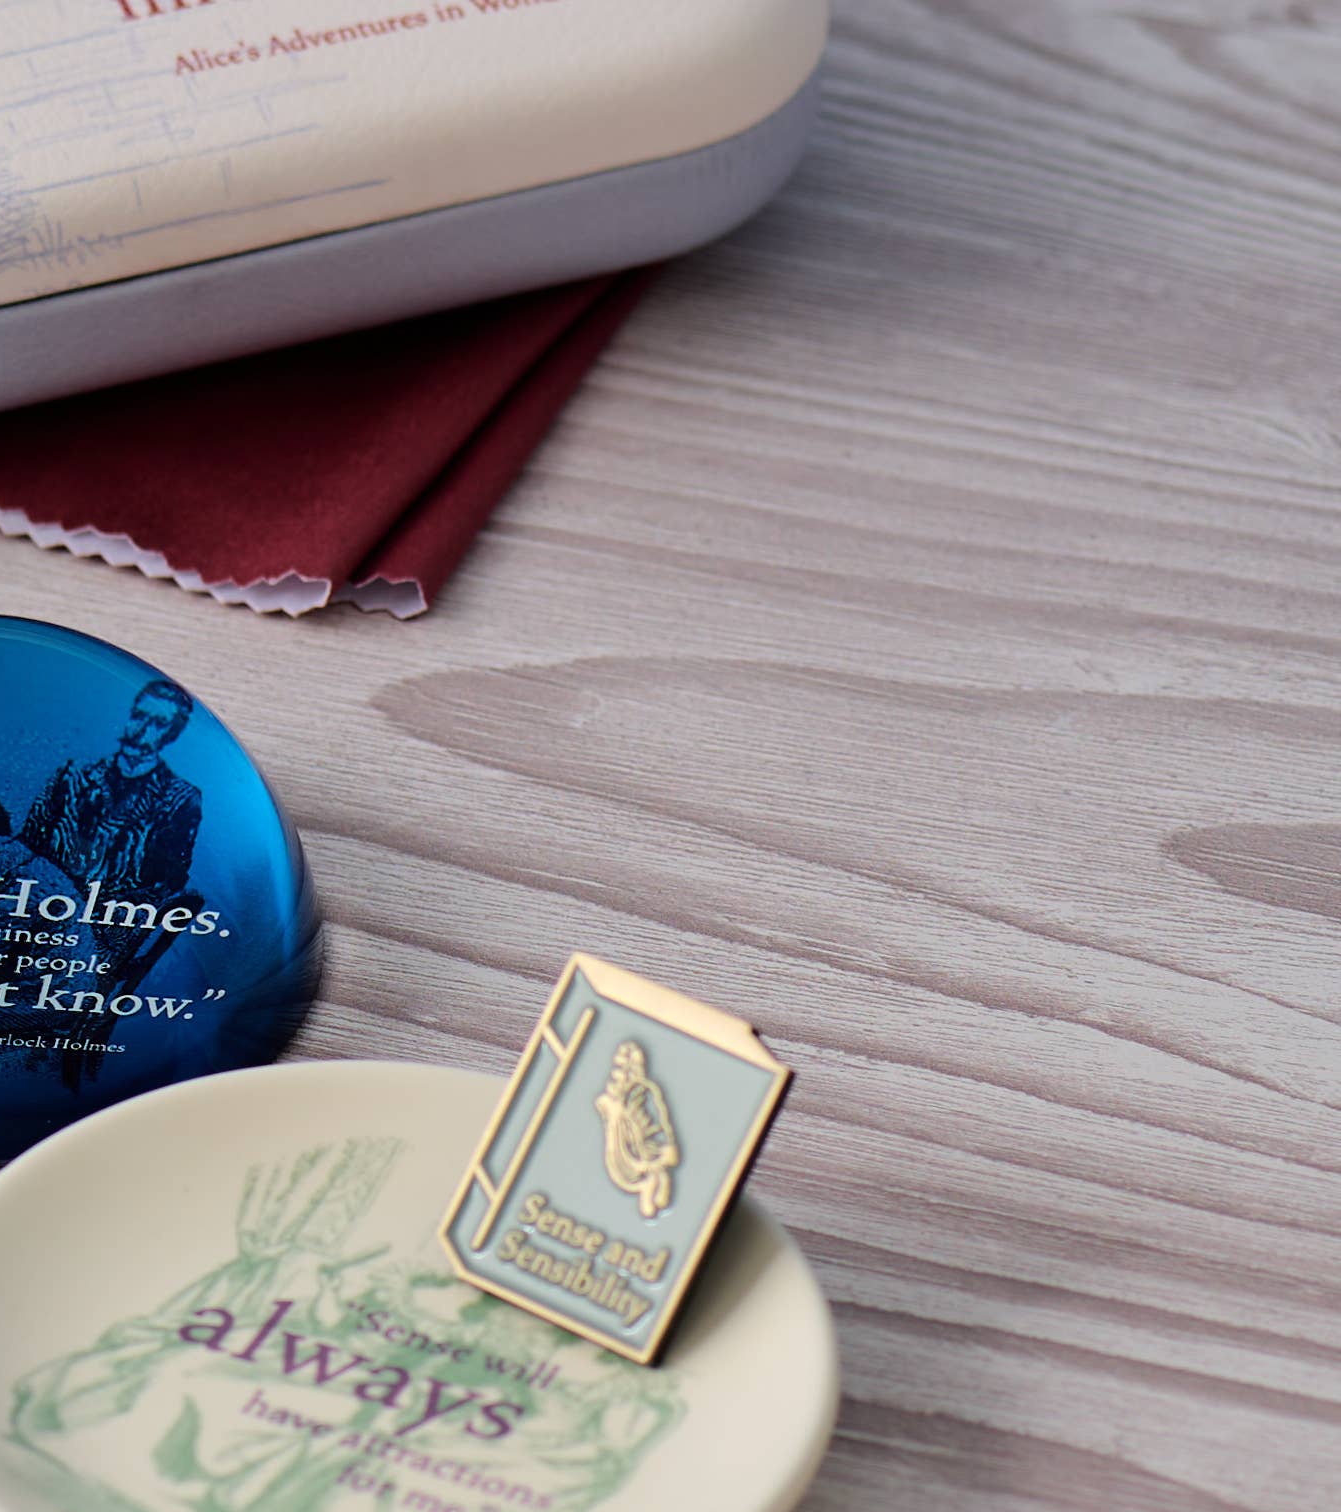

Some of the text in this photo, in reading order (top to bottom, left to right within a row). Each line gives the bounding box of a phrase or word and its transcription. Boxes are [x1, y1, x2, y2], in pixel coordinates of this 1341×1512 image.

[172, 38, 261, 76] Alice’s
[268, 6, 428, 56] Adventures
[434, 0, 465, 22] in
[15, 950, 111, 978] people
[53, 1038, 125, 1054] Holmes
[519, 1192, 671, 1284] Sense and
[497, 1228, 653, 1327] Sensibility
[176, 1298, 526, 1442] always
[484, 1341, 561, 1390] will
[241, 1388, 553, 1512] have attractions
[337, 1457, 397, 1500] for
